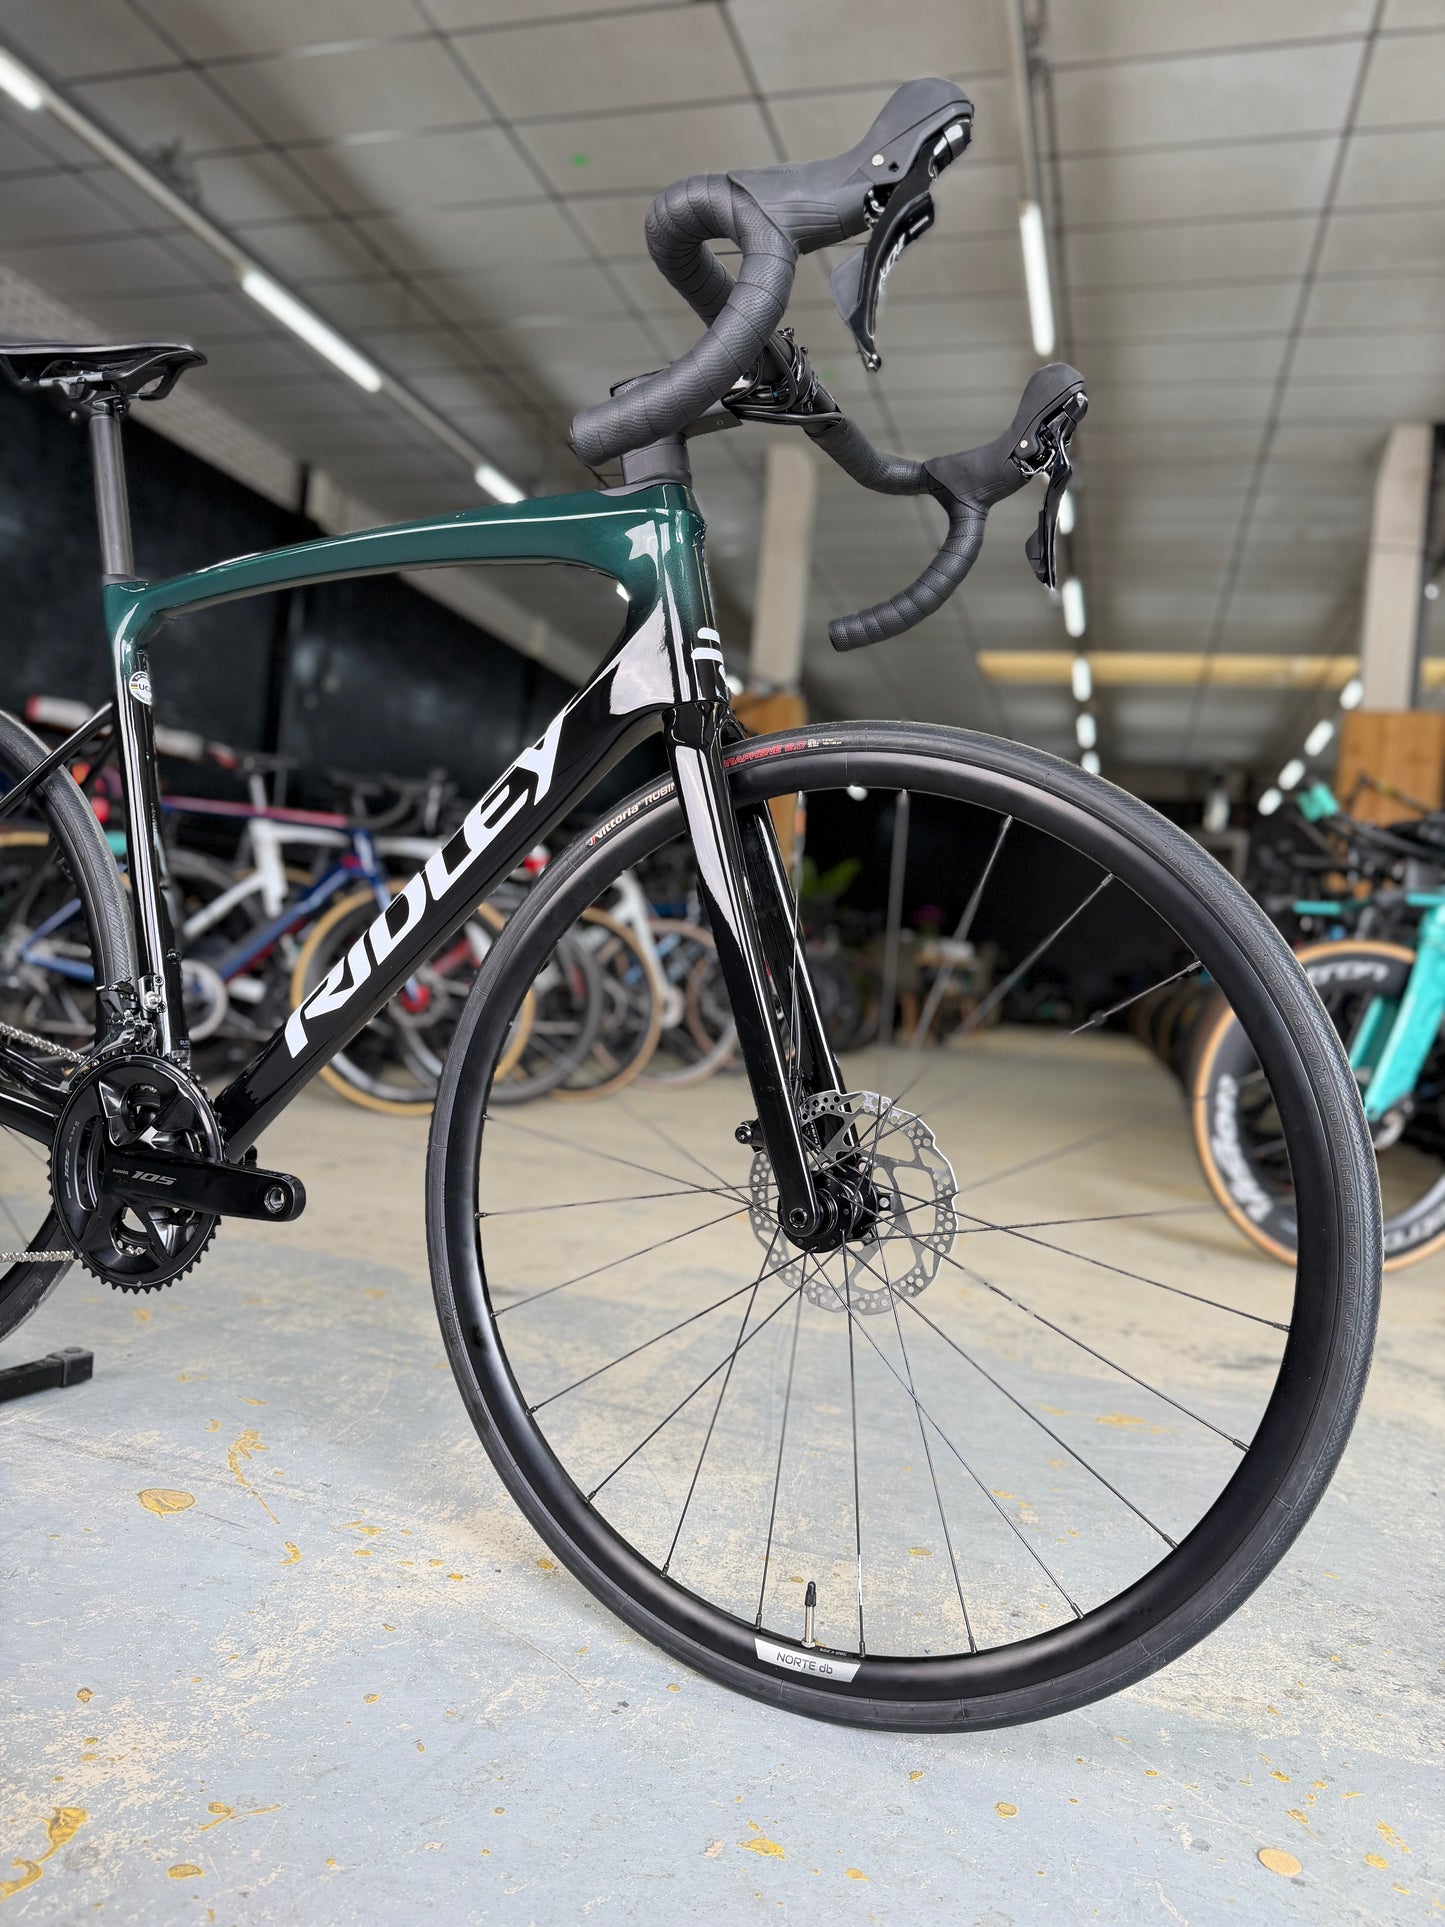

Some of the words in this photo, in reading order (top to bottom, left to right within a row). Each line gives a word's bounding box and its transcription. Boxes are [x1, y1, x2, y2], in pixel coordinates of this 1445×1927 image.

[285, 708, 566, 1059] RIDLEY
[131, 1170, 177, 1186] 105
[776, 1651, 817, 1671] NORTE
[818, 1663, 834, 1675] db
